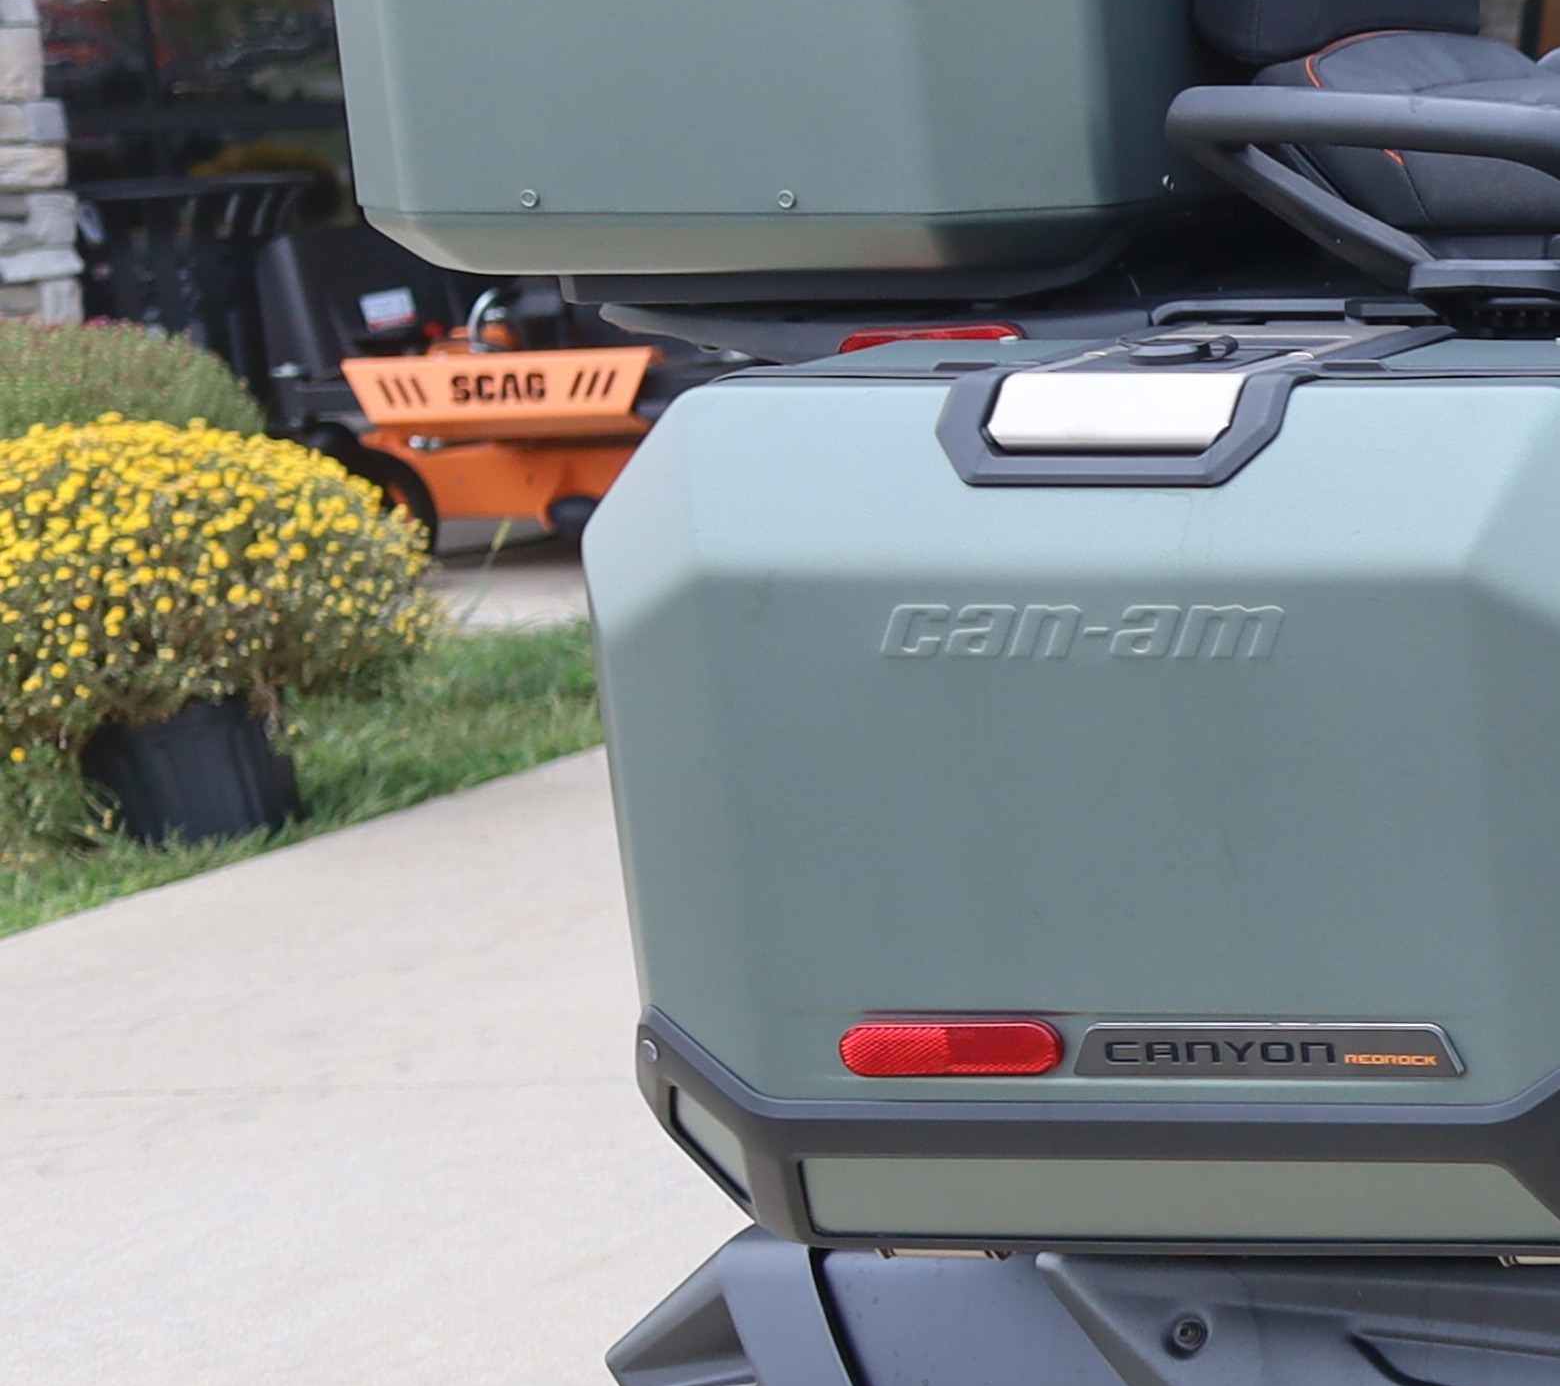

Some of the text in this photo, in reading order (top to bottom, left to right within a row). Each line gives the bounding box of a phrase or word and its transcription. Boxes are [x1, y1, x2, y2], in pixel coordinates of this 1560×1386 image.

[451, 372, 546, 403] SCAG
[880, 603, 1285, 659] can-am
[1104, 1041, 1438, 1066] CANYON REDROCK
